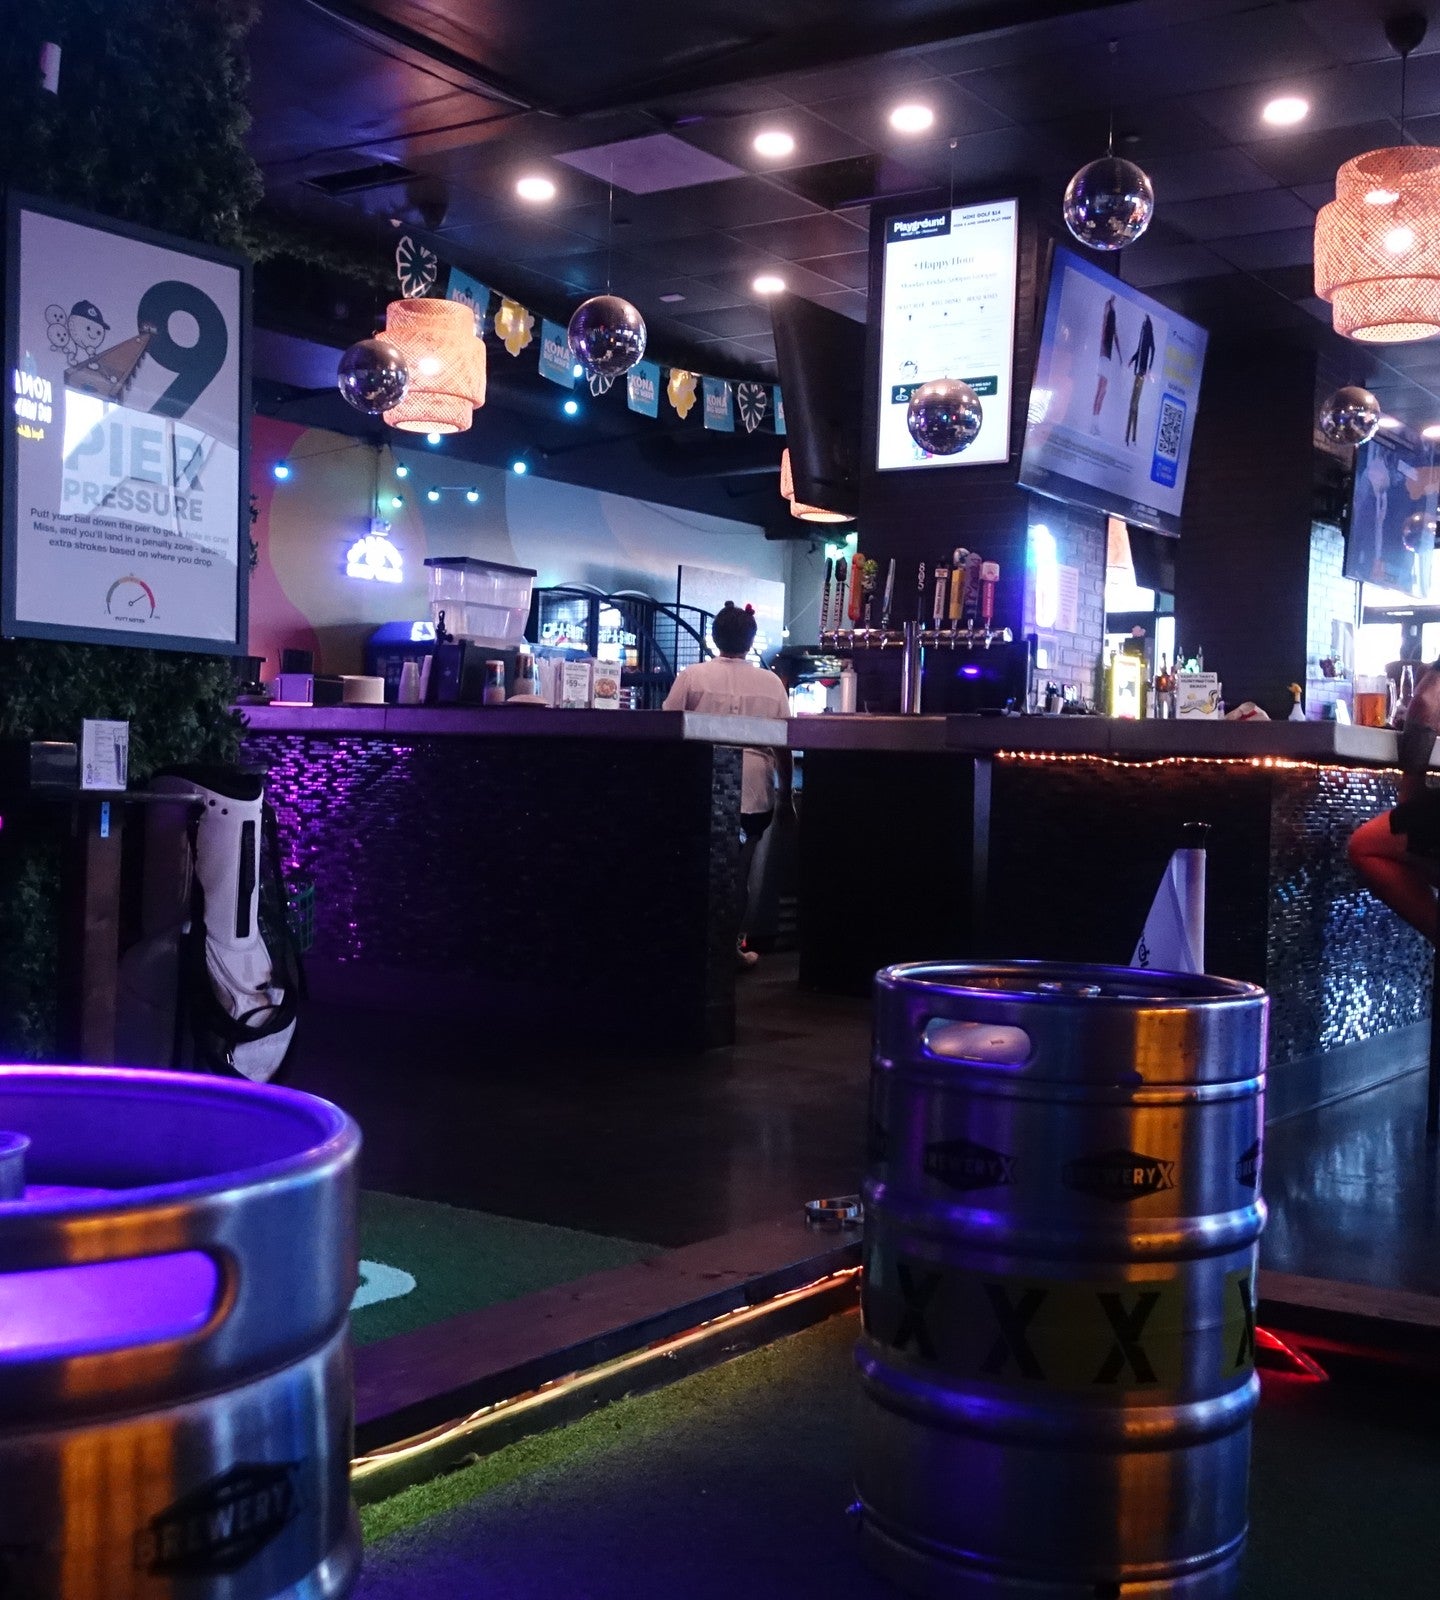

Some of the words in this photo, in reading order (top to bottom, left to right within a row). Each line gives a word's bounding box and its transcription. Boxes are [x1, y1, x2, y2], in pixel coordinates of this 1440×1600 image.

[894, 216, 946, 233] Playground
[977, 211, 991, 219] GOLF
[919, 259, 949, 270] Happy
[137, 280, 228, 419] 9
[543, 338, 570, 360] KONA
[631, 376, 654, 391] KONA
[706, 394, 727, 407] KONA
[65, 421, 204, 491] PIER
[63, 478, 204, 522] PRESSURE
[30, 508, 50, 519] Putt
[52, 512, 73, 523] your
[74, 513, 91, 524] ball
[92, 516, 117, 528] down
[119, 520, 132, 530] the
[134, 523, 150, 534] pier
[152, 525, 161, 535] to
[33, 522, 58, 534] Miss,
[60, 526, 77, 536] and
[77, 528, 103, 540] you'll
[104, 532, 123, 542] land
[125, 534, 133, 543] in
[142, 537, 172, 550] penalty
[174, 542, 194, 552] zone
[49, 539, 73, 549] extra
[75, 542, 107, 553] strokes
[109, 545, 136, 556] based
[137, 550, 148, 558] on
[150, 551, 175, 562] where
[177, 555, 192, 565] you
[917, 562, 926, 590] 805
[979, 1282, 1049, 1381] X
[1092, 1292, 1162, 1384] X
